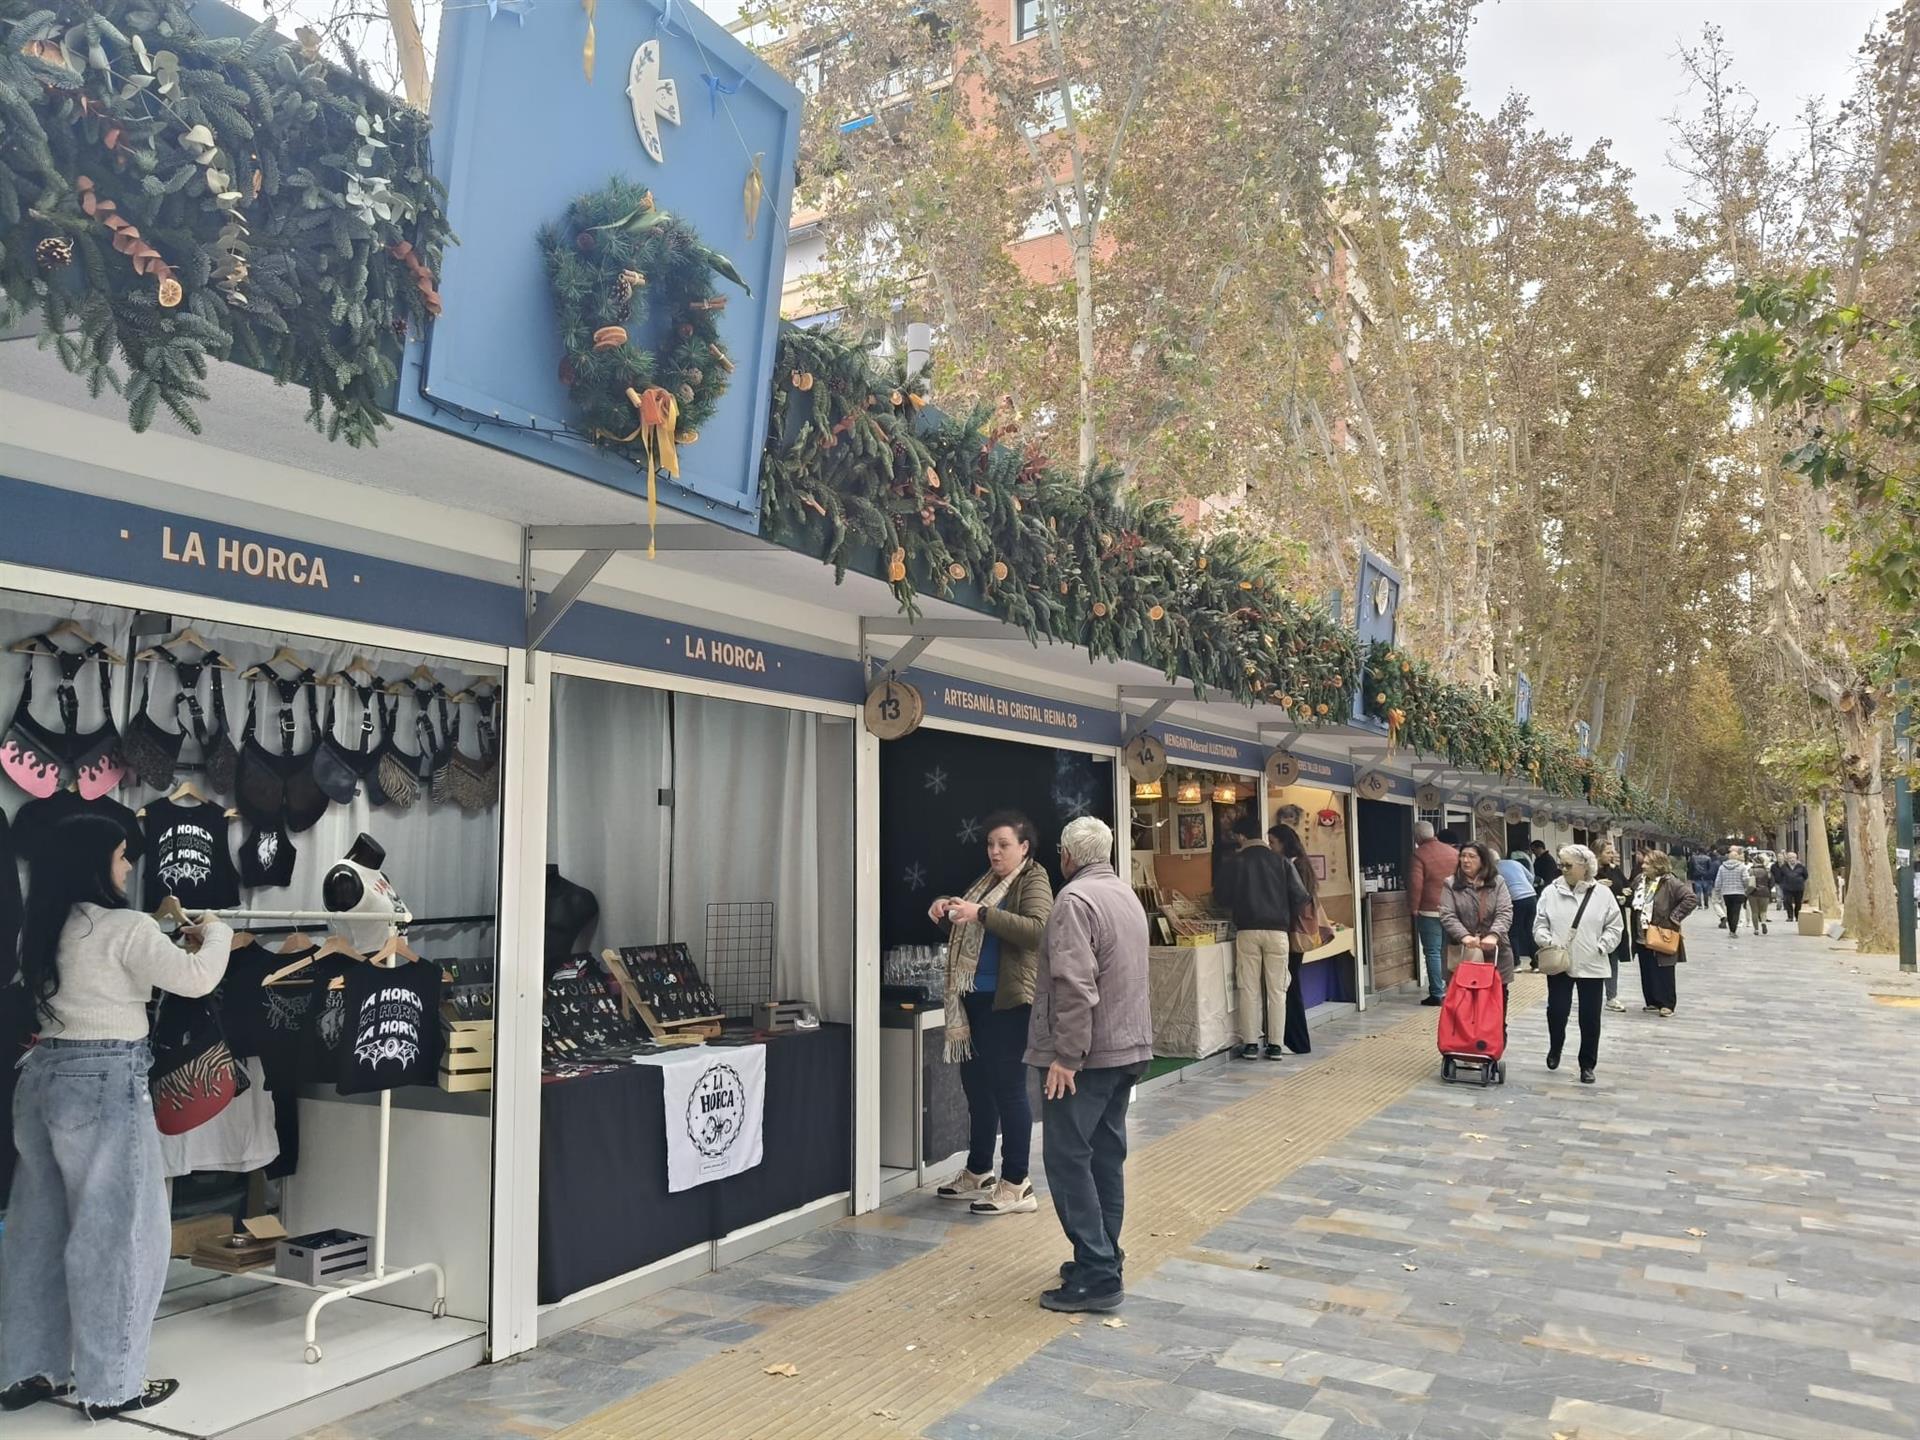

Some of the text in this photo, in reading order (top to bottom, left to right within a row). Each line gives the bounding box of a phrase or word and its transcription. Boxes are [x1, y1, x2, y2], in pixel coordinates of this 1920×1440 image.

[162, 526, 329, 588] LA HORCA
[685, 634, 766, 673] LA HORCA
[878, 698, 901, 721] 13
[944, 687, 996, 714] ARTESANÍA
[997, 699, 1009, 717] EN
[1010, 702, 1043, 723] CRISTAL
[1043, 708, 1067, 727] REINA
[1137, 748, 1155, 766] 14
[1275, 763, 1290, 776] 15
[1369, 777, 1382, 792] 16
[325, 998, 344, 1008] SHI
[329, 990, 343, 999] EA
